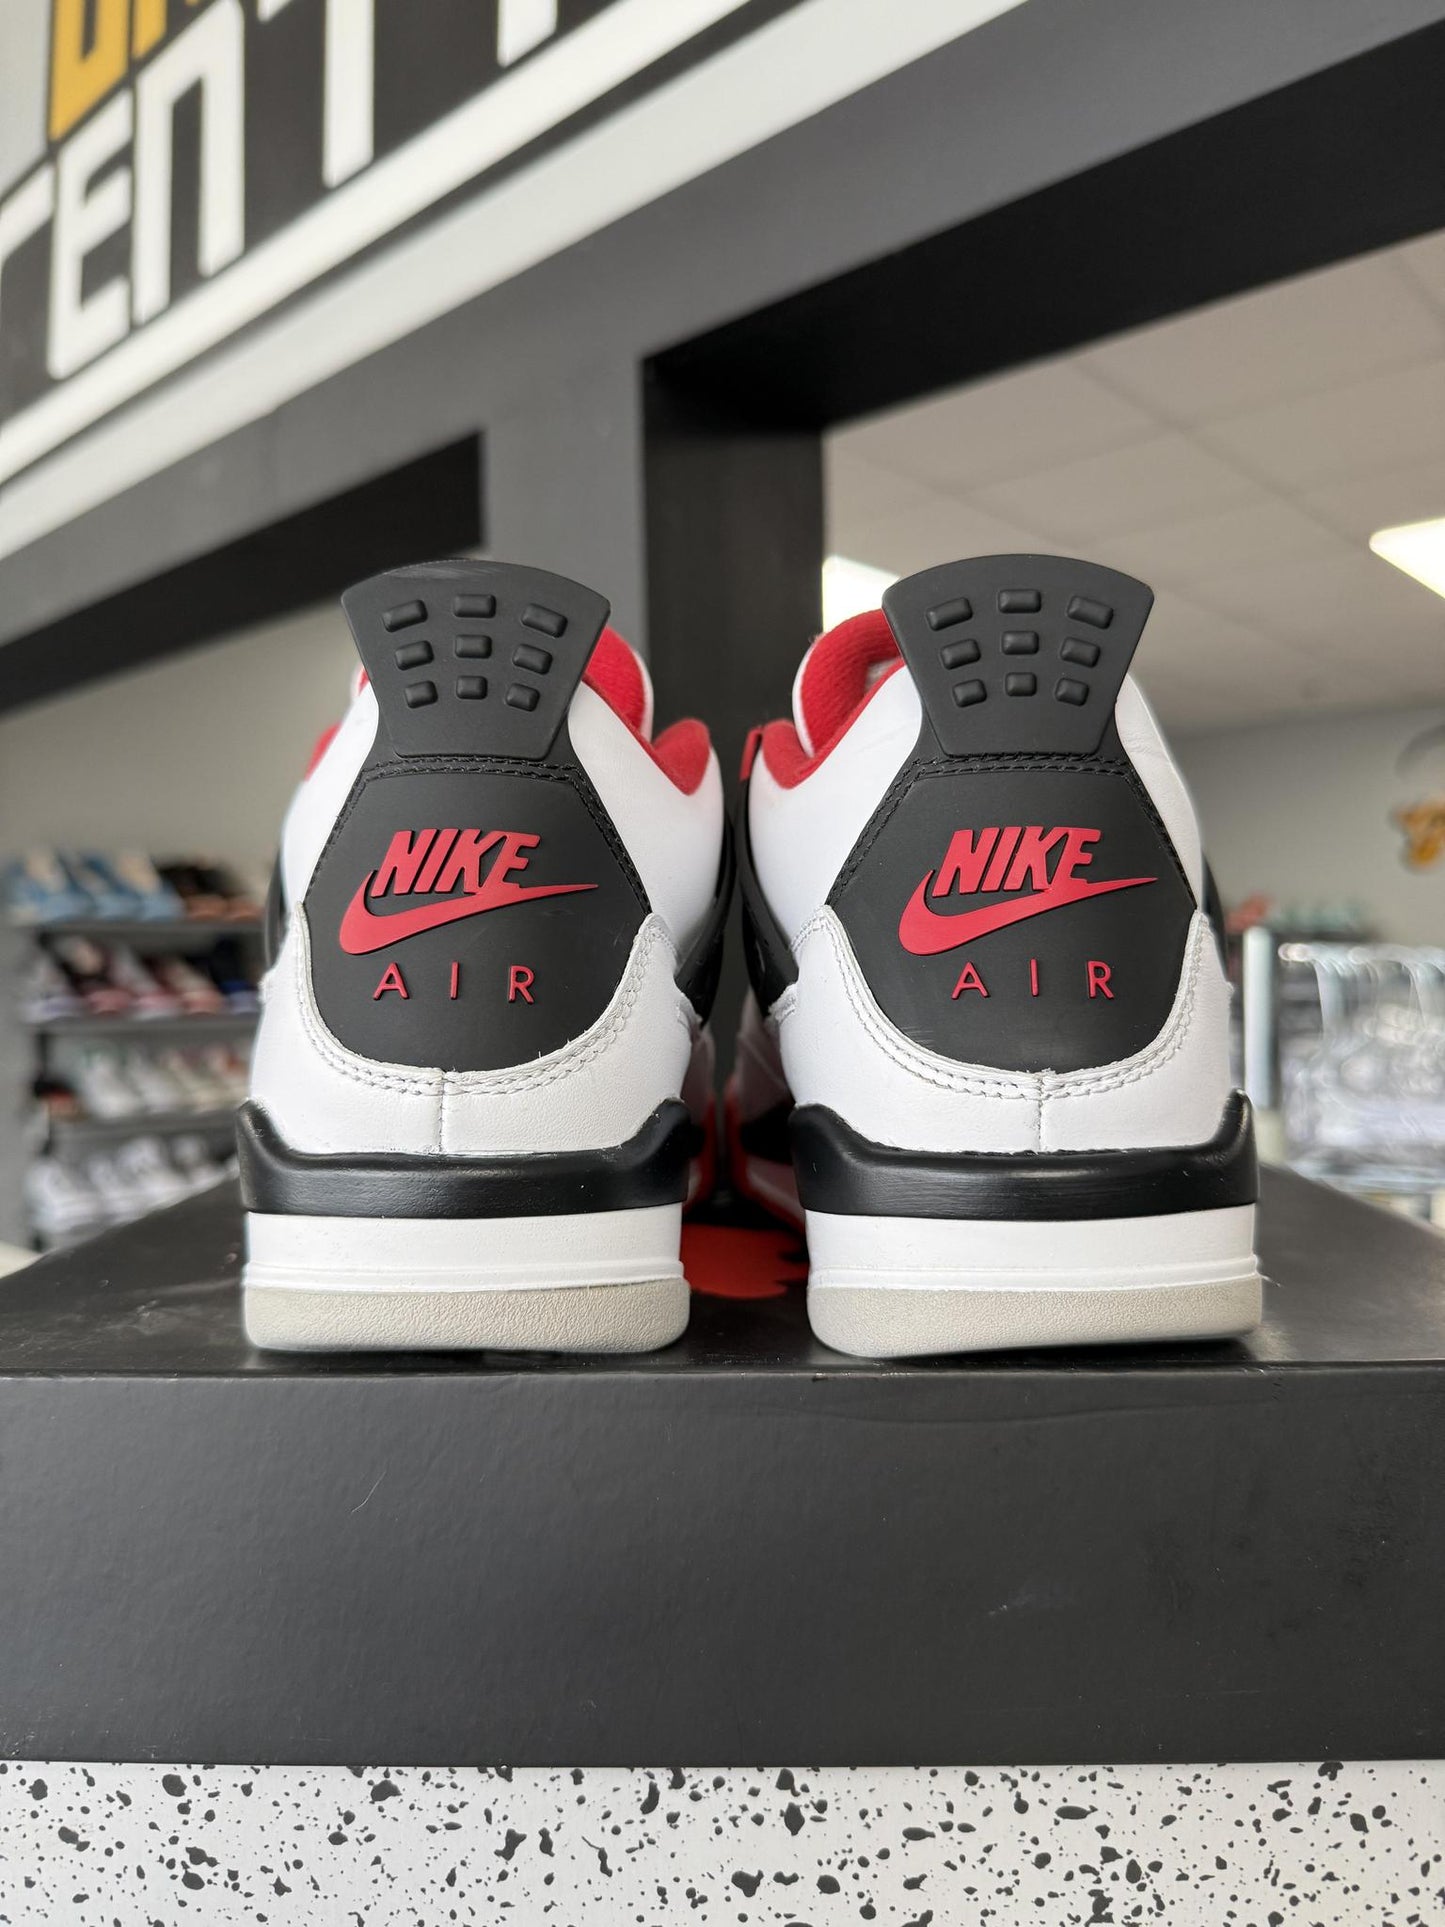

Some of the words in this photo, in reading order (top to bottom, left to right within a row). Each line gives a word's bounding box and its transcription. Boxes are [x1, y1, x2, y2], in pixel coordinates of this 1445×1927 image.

[371, 828, 541, 897] NIKE
[932, 826, 1102, 897] NIKE
[373, 961, 535, 1004] AIR
[952, 958, 1114, 999] AIR
